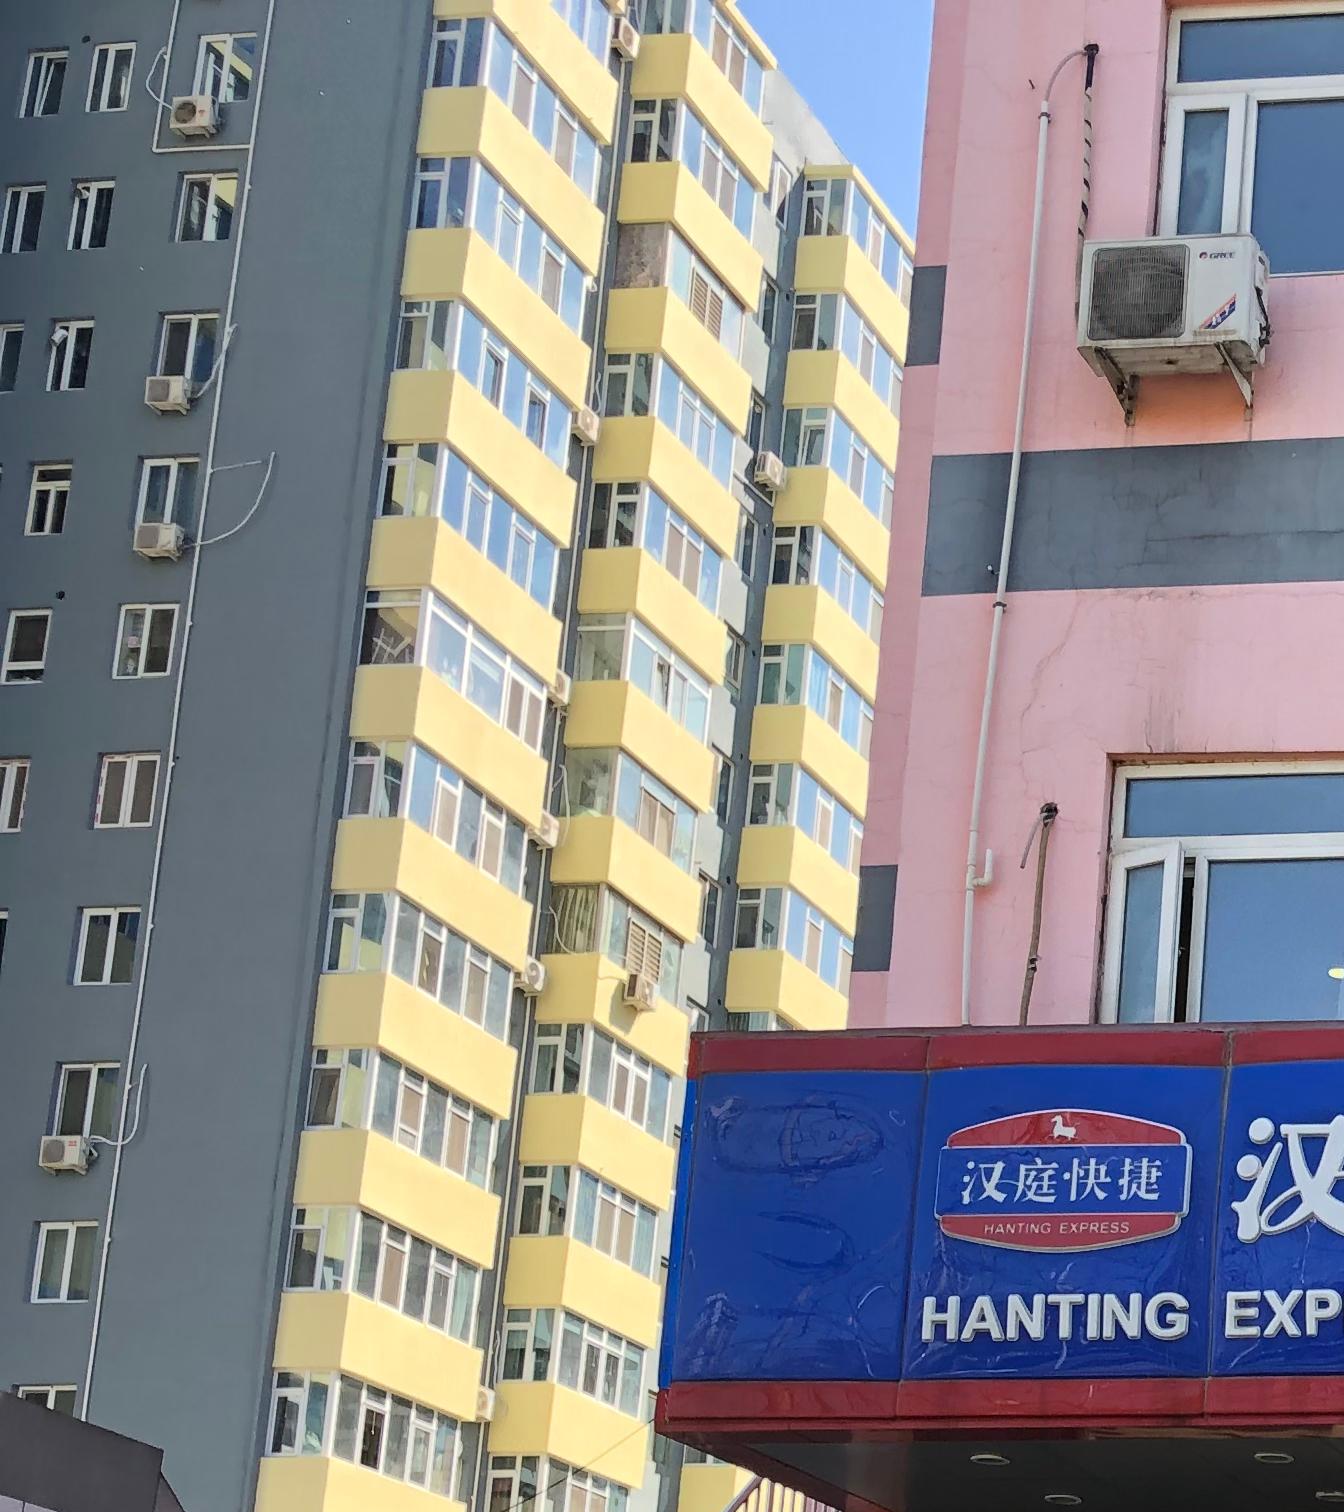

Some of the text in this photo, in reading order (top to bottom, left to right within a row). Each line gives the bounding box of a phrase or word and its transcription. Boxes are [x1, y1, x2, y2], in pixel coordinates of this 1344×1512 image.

[961, 1157, 1163, 1205] 汉庭快捷
[984, 1221, 1130, 1235] HANTING EXPRESS
[921, 1293, 1190, 1343] HANTING
